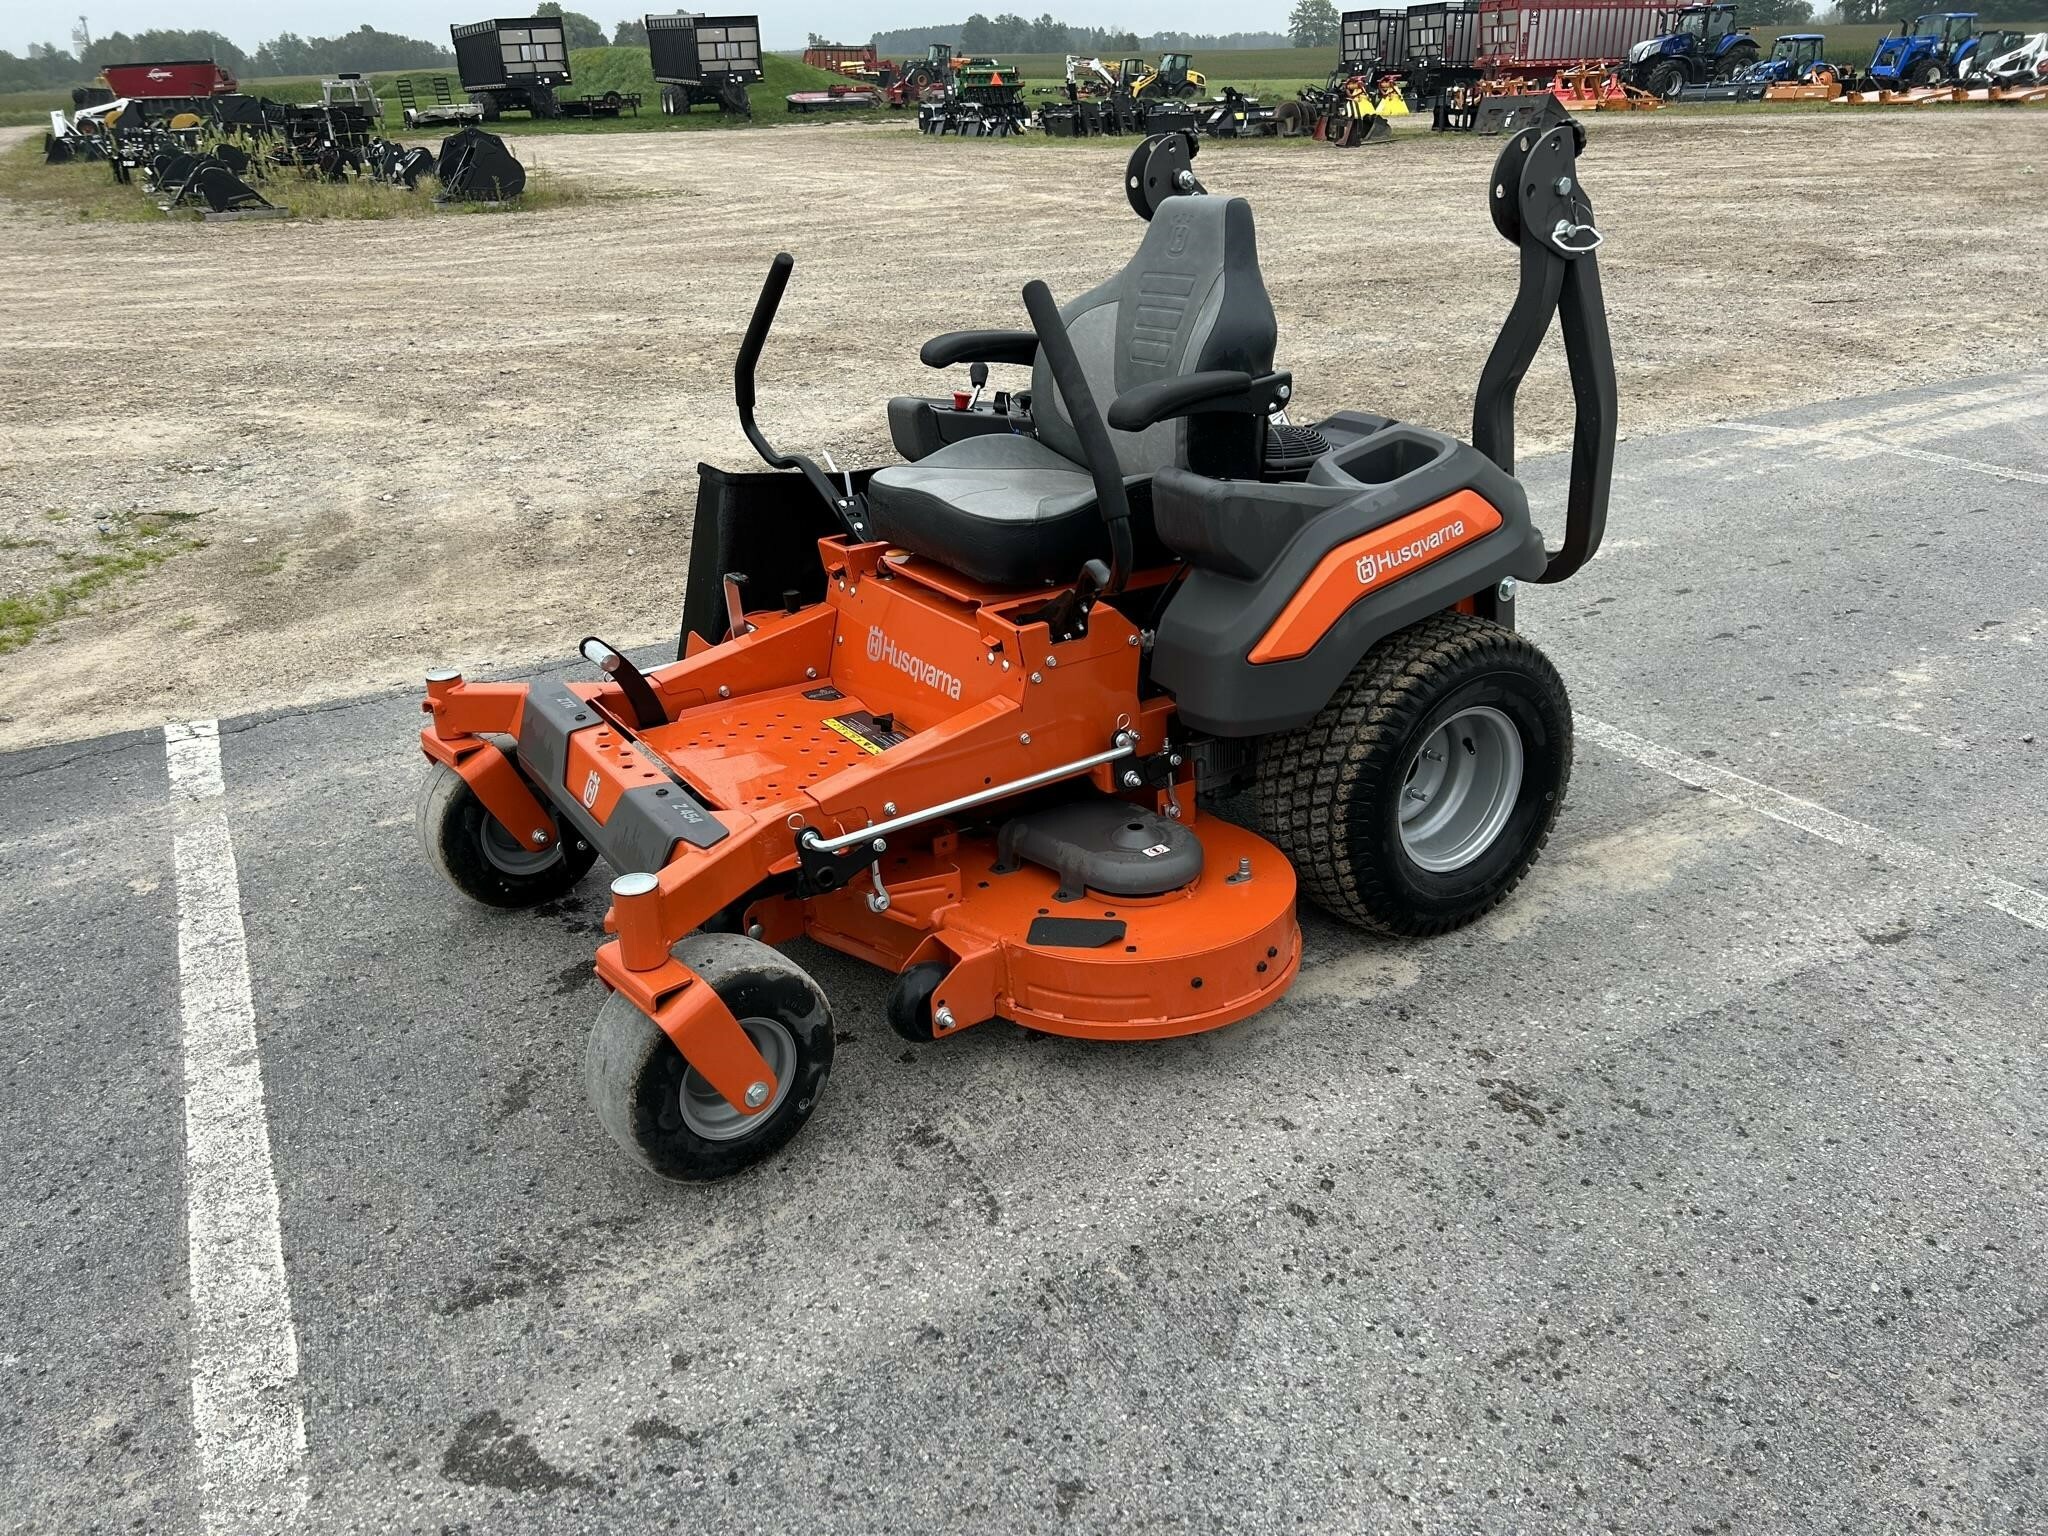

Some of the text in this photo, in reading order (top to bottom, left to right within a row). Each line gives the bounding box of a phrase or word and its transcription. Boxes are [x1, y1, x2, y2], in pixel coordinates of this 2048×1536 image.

[1377, 520, 1465, 573] Husqvarna
[881, 635, 962, 701] Husqvarna
[555, 697, 577, 709] ZTR
[680, 810, 704, 824] 454
